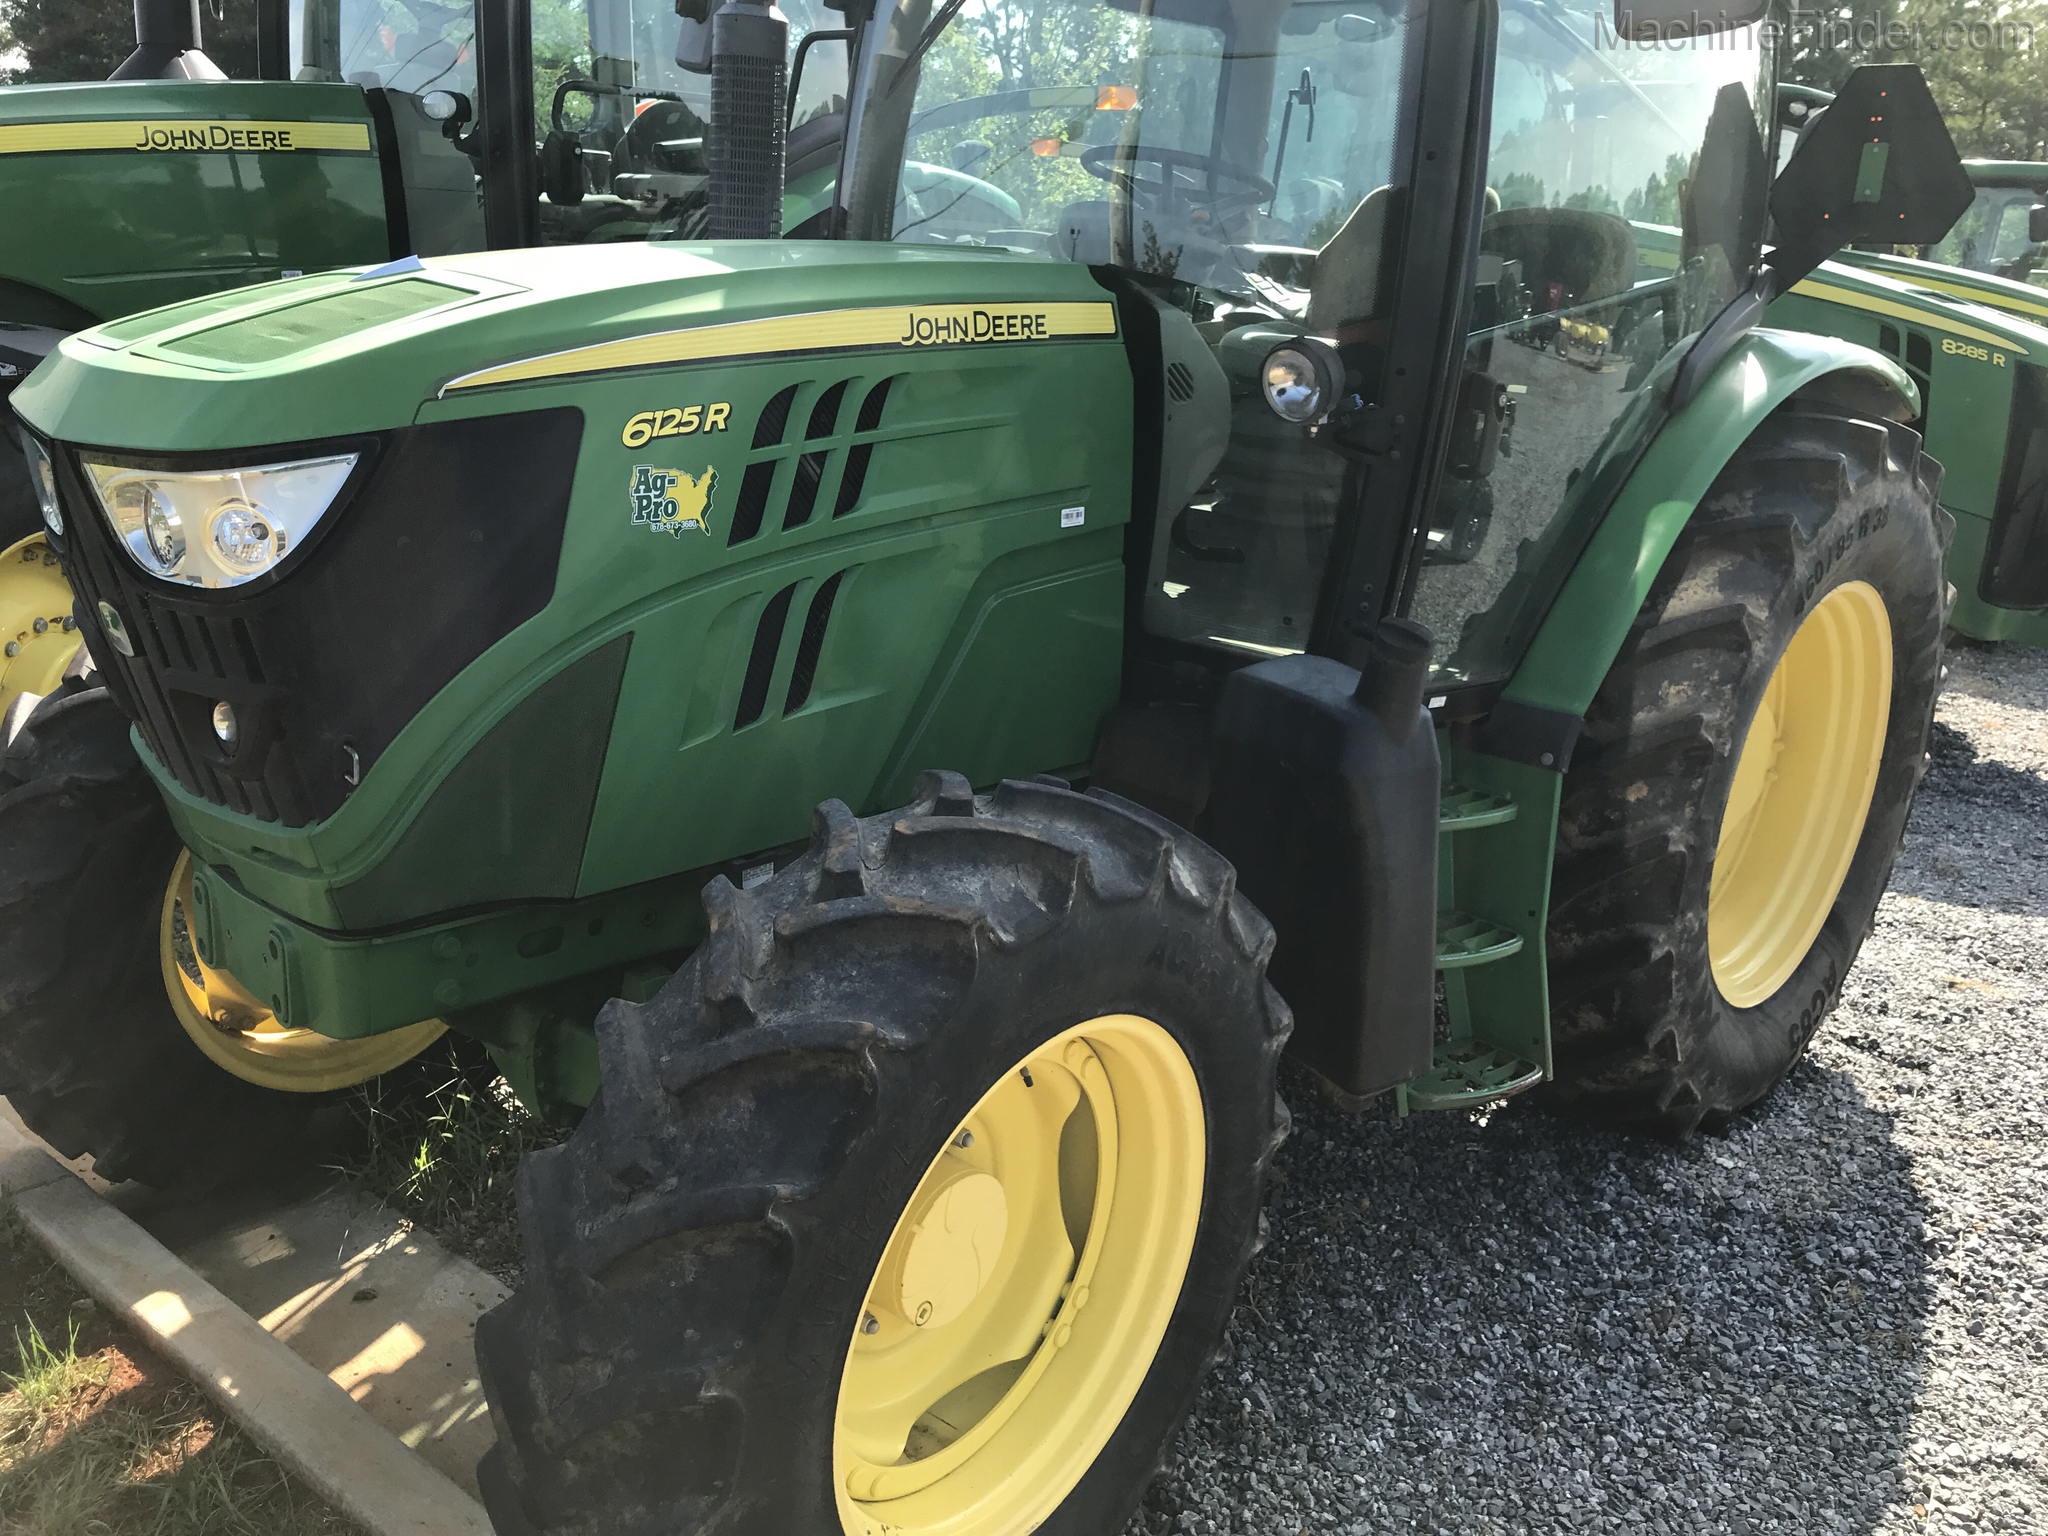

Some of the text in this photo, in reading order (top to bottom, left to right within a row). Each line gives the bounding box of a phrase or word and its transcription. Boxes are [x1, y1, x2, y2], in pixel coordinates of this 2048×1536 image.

[136, 125, 293, 148] JOHN DEERE
[901, 311, 1047, 342] JOHN DEERE
[1942, 338, 2006, 368] 8285 R
[621, 401, 732, 450] 6125 R
[631, 466, 678, 499] Ag-
[631, 494, 679, 523] Pro
